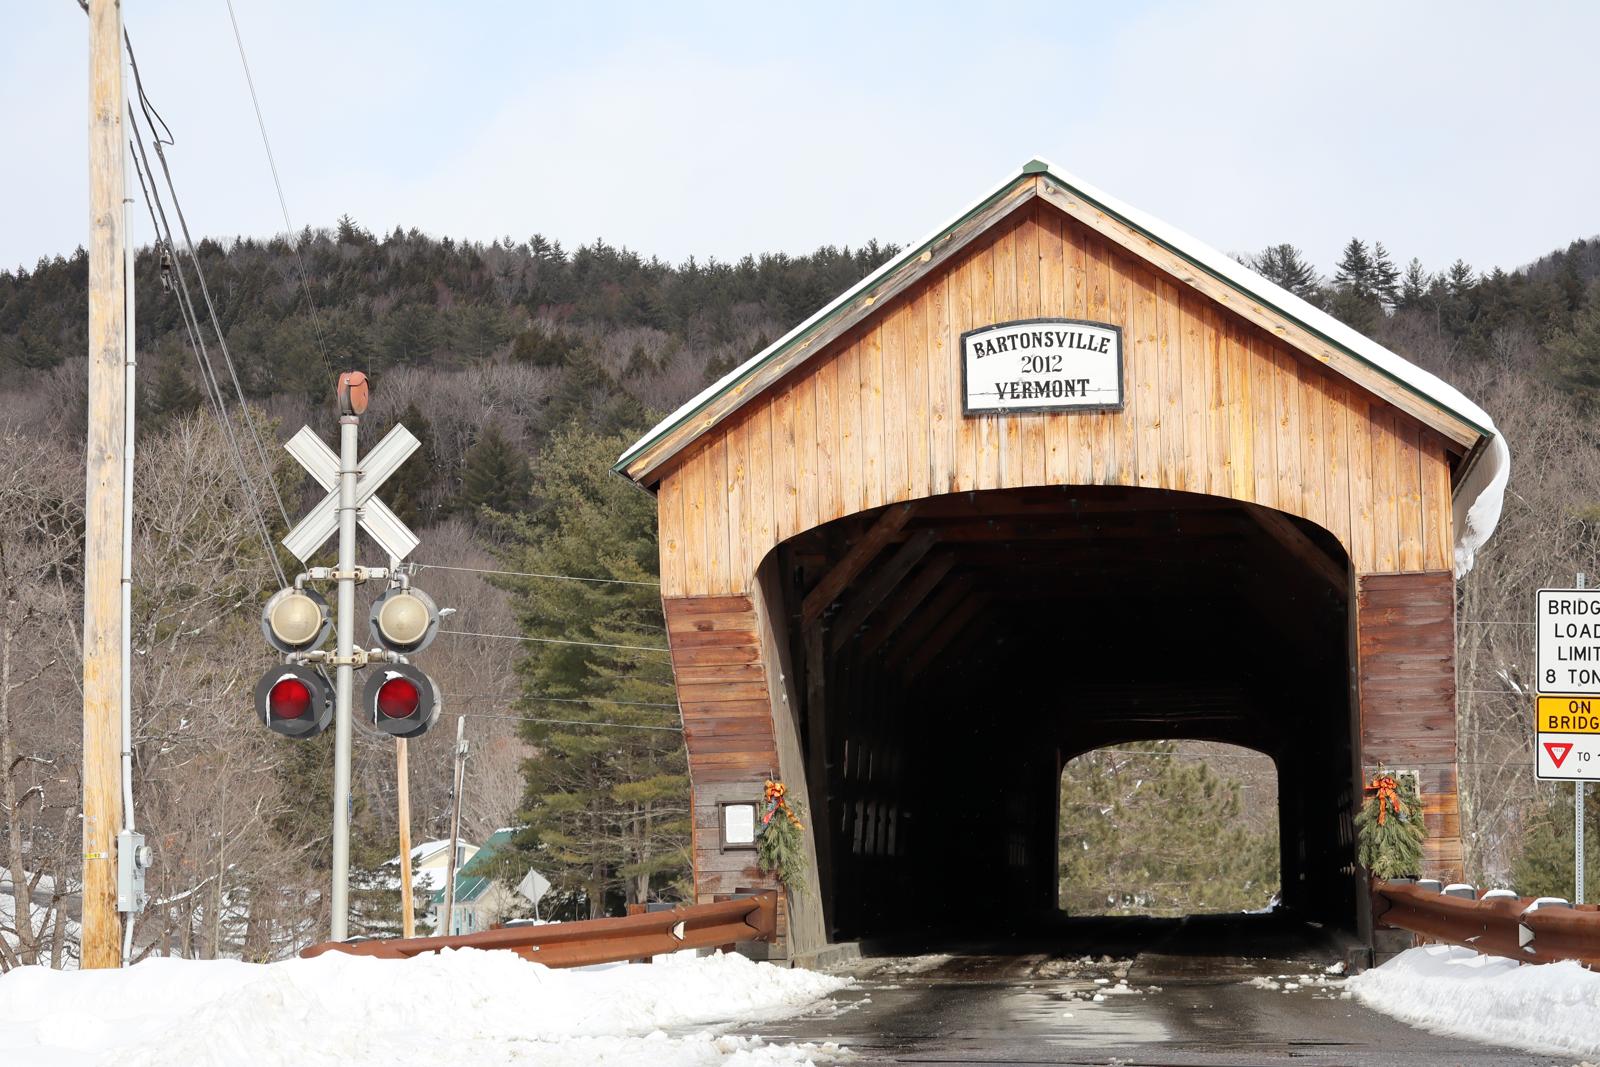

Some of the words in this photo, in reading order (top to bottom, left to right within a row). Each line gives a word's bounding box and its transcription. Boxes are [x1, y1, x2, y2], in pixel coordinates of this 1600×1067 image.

[973, 331, 1111, 359] BARTONSVILLE
[1021, 355, 1063, 373] 2012
[995, 379, 1090, 400] VERMONT
[1548, 600, 1600, 615] BRIDG
[1558, 646, 1600, 661] LIMIT
[1545, 669, 1556, 684] 8
[1568, 669, 1600, 684] TON
[1568, 700, 1591, 714] ON
[1548, 716, 1600, 729] BRIDG
[1577, 752, 1591, 762] TO
